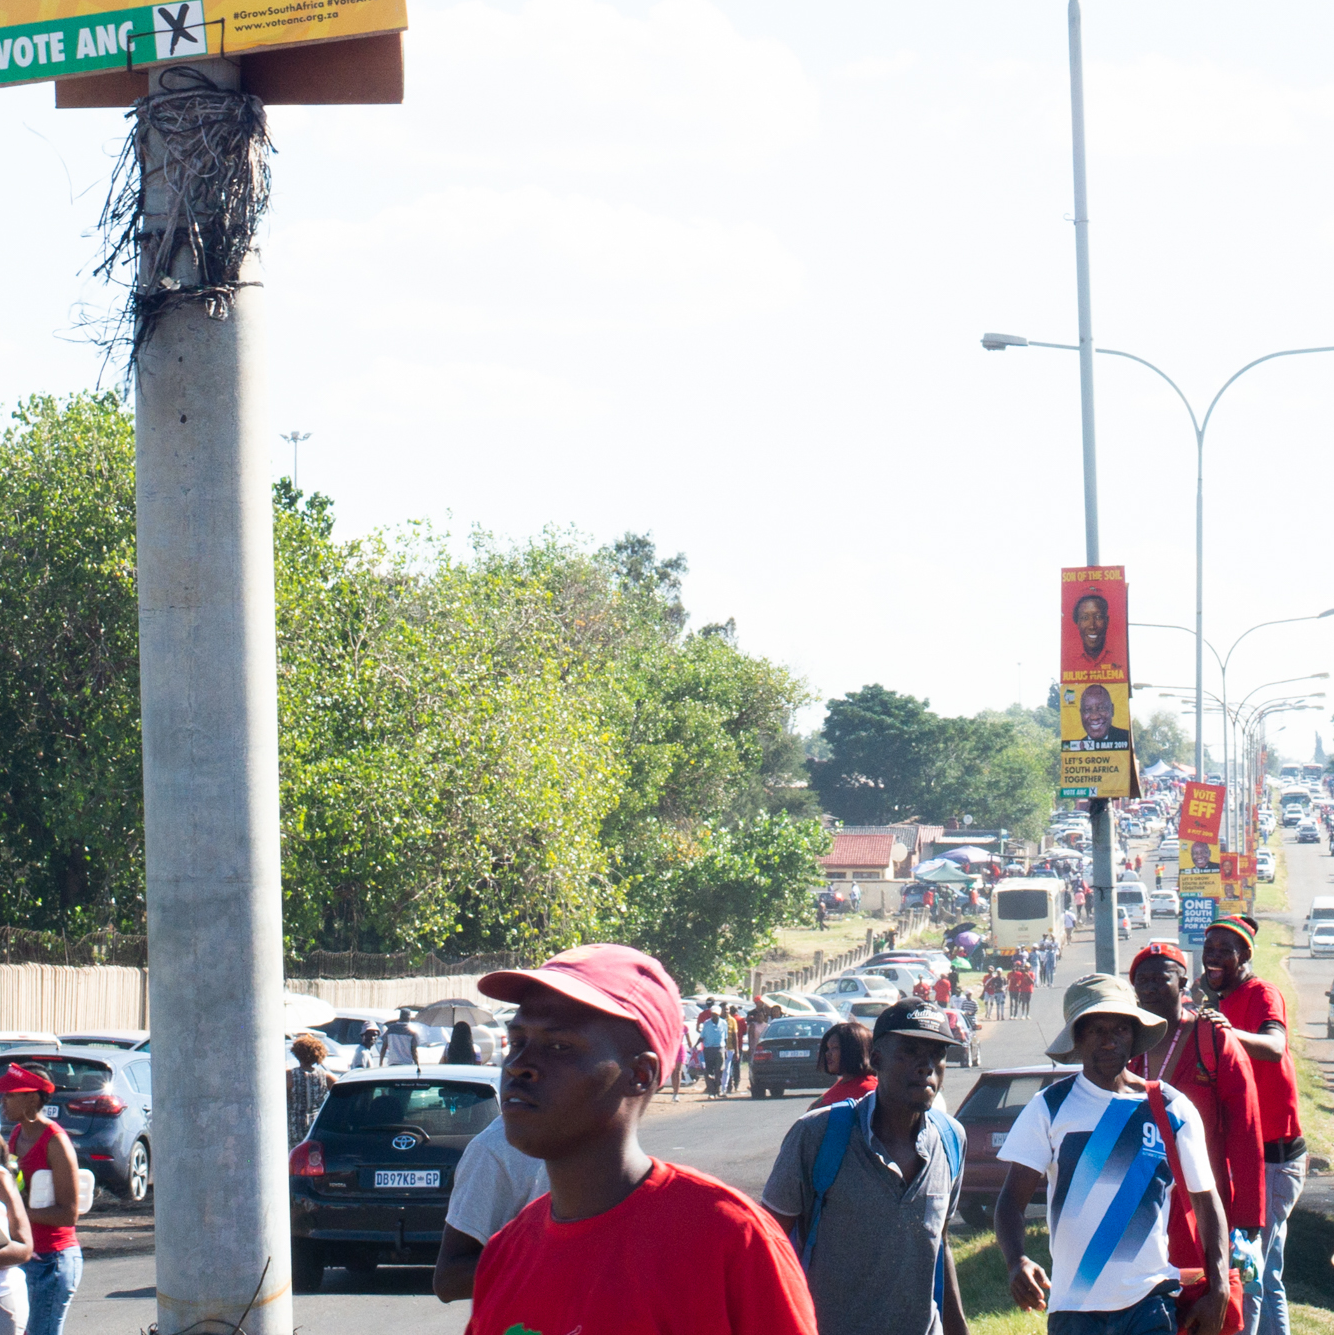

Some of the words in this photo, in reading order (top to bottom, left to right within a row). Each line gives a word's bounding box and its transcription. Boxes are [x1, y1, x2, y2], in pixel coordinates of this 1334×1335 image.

[233, 1, 325, 21] #GrowSouthAfrica
[234, 12, 339, 32] www.voteanc.org.za
[76, 21, 136, 59] ANC
[1063, 572, 1076, 582] SON
[1077, 572, 1086, 581] OF
[1088, 571, 1102, 580] THE
[1104, 570, 1123, 580] SOIL
[1063, 671, 1088, 681] JULIUS
[1089, 669, 1125, 680] MALEMA
[1101, 741, 1113, 749] MAY
[1064, 757, 1083, 765] LET'S
[1085, 756, 1110, 764] GROW
[1193, 789, 1216, 802] VOTE
[1188, 800, 1217, 819] EFF
[1185, 900, 1212, 910] ONE
[47, 1107, 57, 1115] GP
[376, 1173, 417, 1186] DB97KB
[425, 1173, 439, 1186] GP
